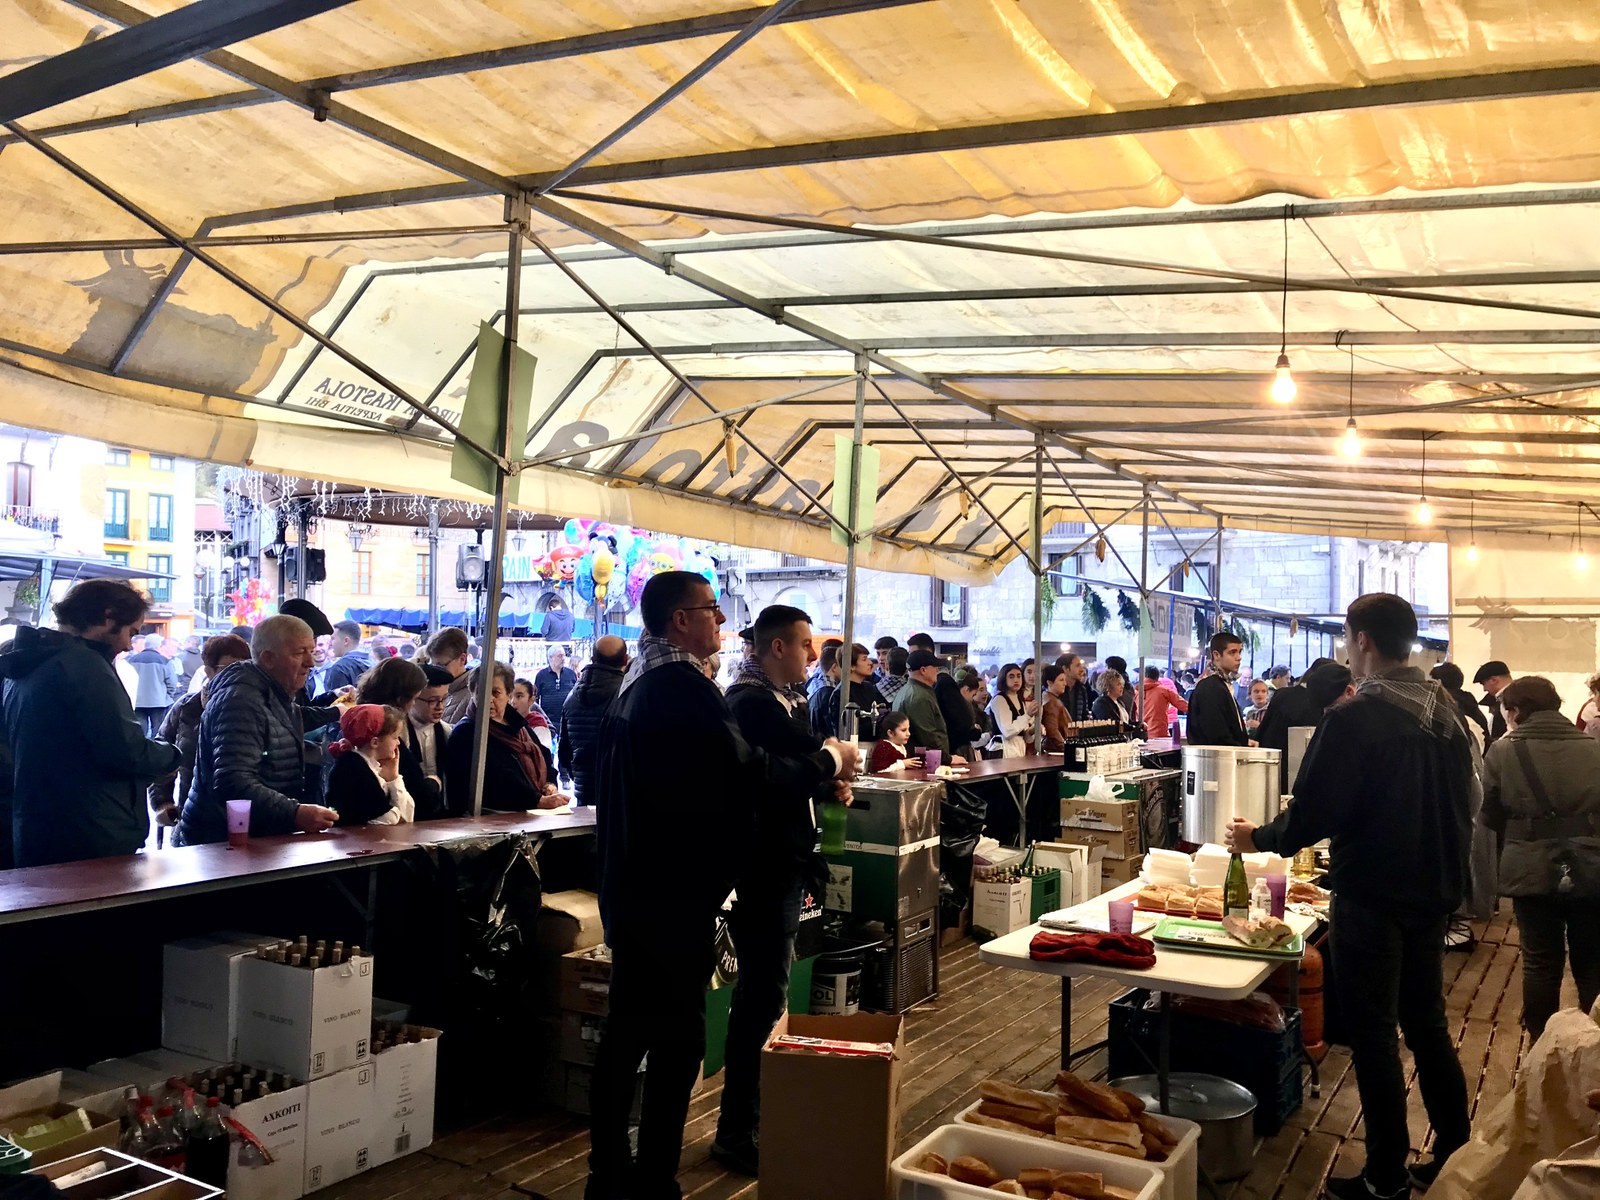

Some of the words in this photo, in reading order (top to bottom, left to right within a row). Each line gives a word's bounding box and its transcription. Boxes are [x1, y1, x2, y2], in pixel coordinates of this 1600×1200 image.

[799, 909, 822, 922] eineken
[814, 990, 832, 1001] OL
[323, 1015, 338, 1024] VINO
[340, 1009, 361, 1021] BLANCO
[262, 1102, 301, 1124] AXKOITI
